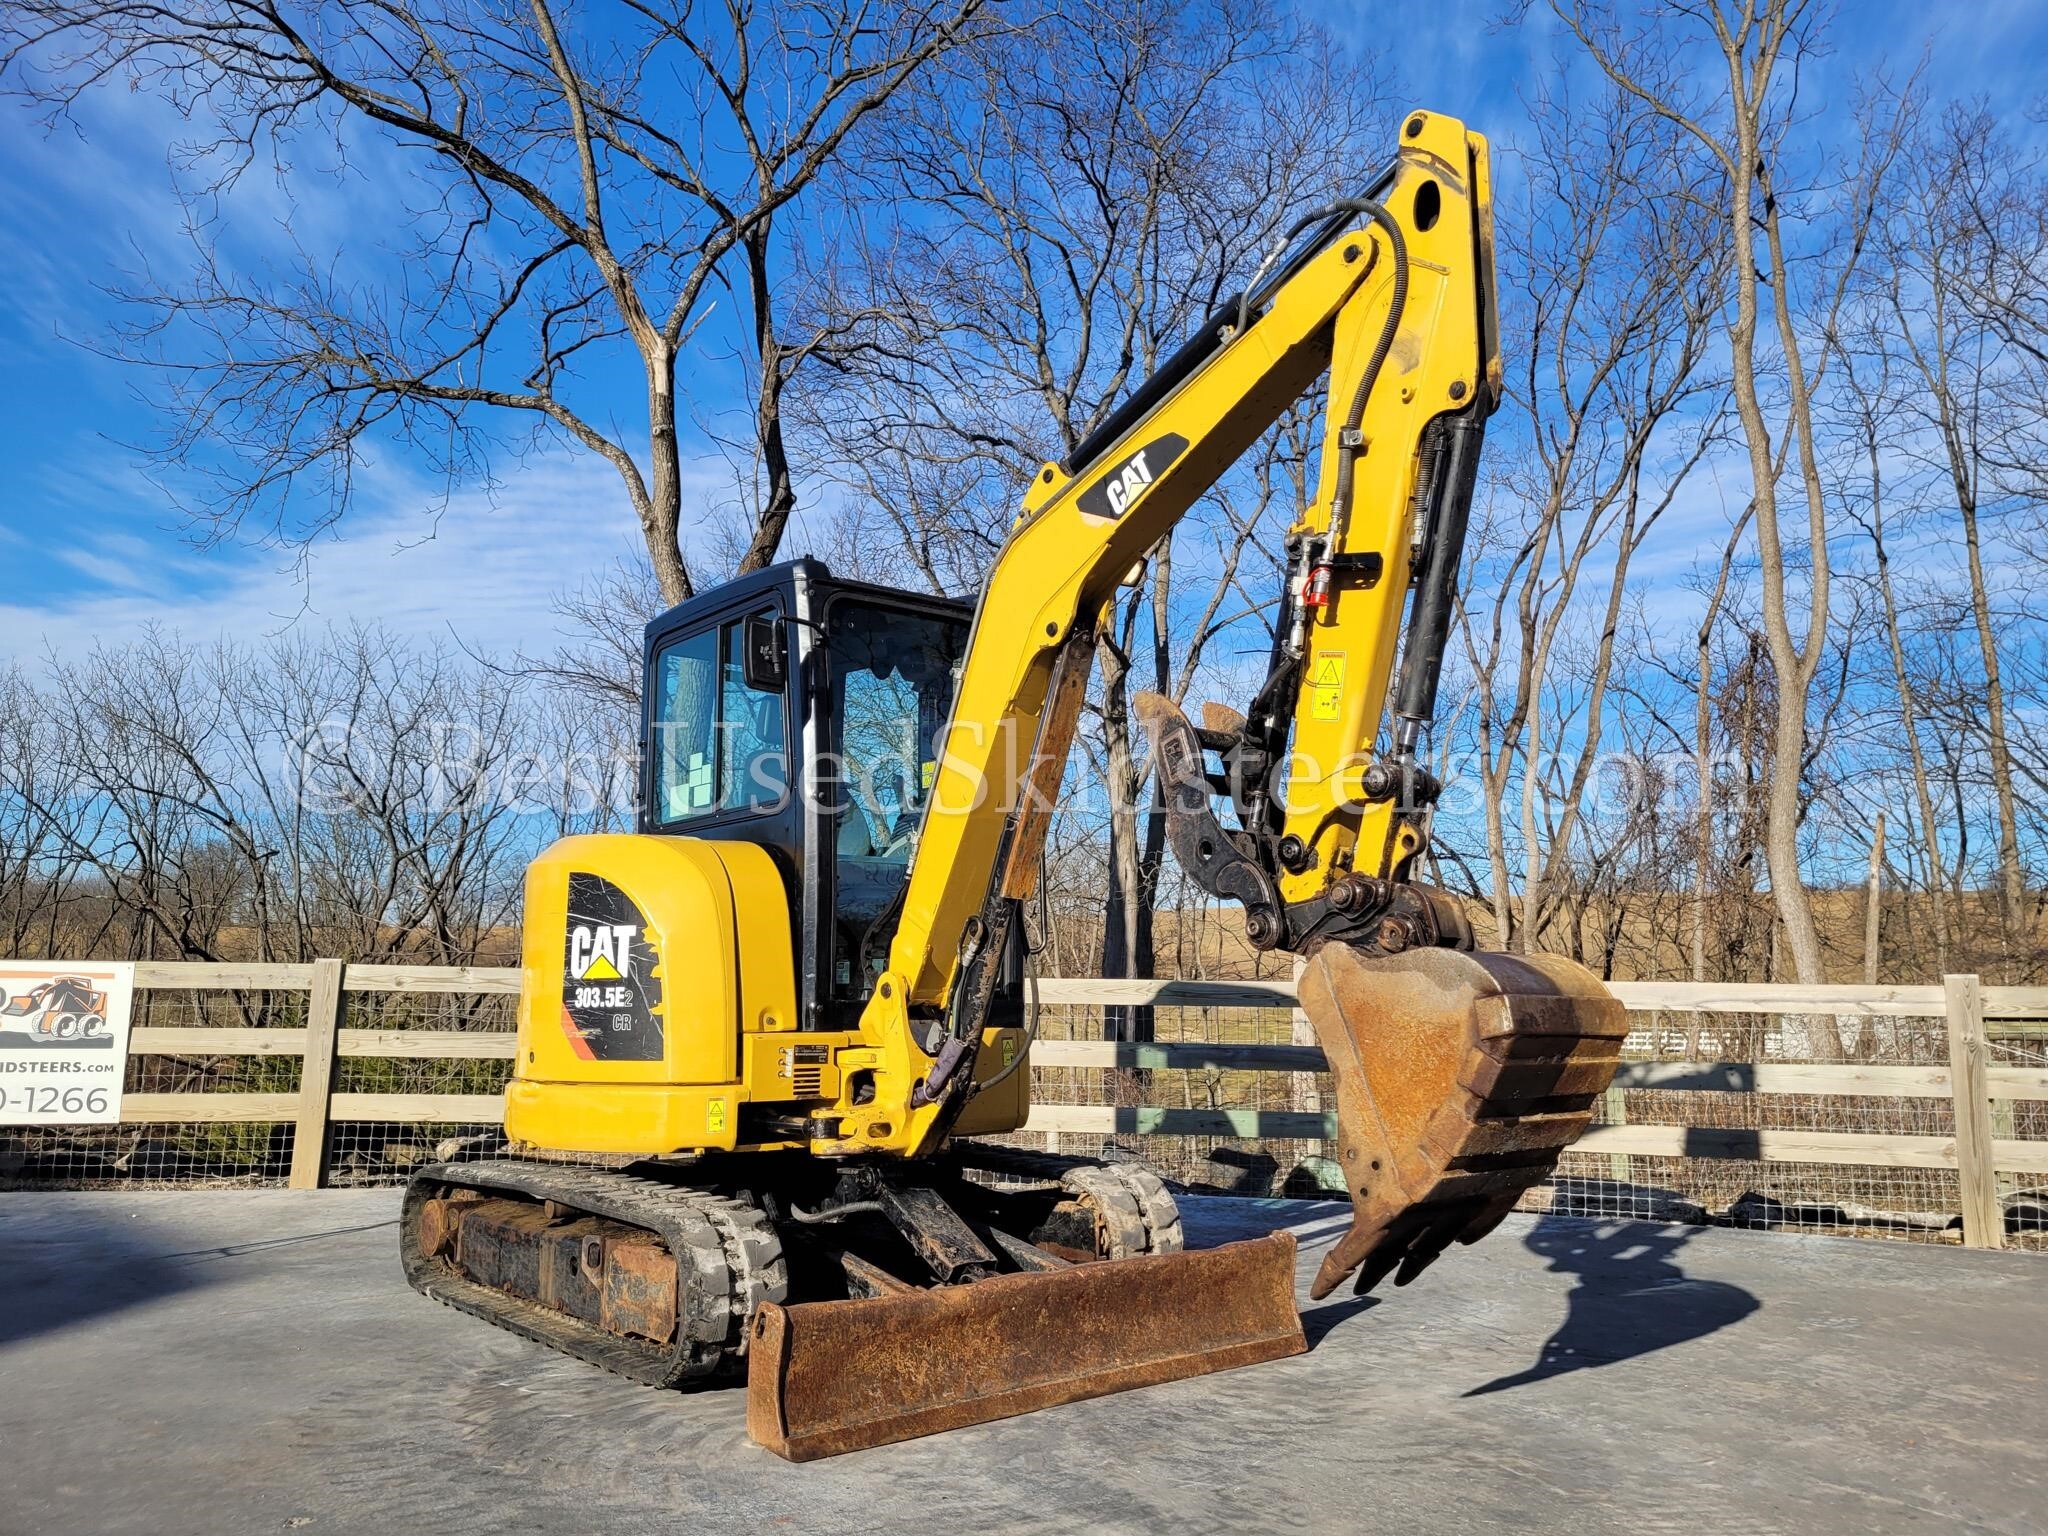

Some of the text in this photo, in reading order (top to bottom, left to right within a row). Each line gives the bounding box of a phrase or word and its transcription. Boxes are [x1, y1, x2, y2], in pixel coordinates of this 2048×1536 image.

[1106, 449, 1153, 516] CAT
[571, 924, 637, 980] CAT
[574, 986, 634, 1009] 303.5E2
[612, 1013, 633, 1032] CR
[0, 1086, 109, 1114] -1266
